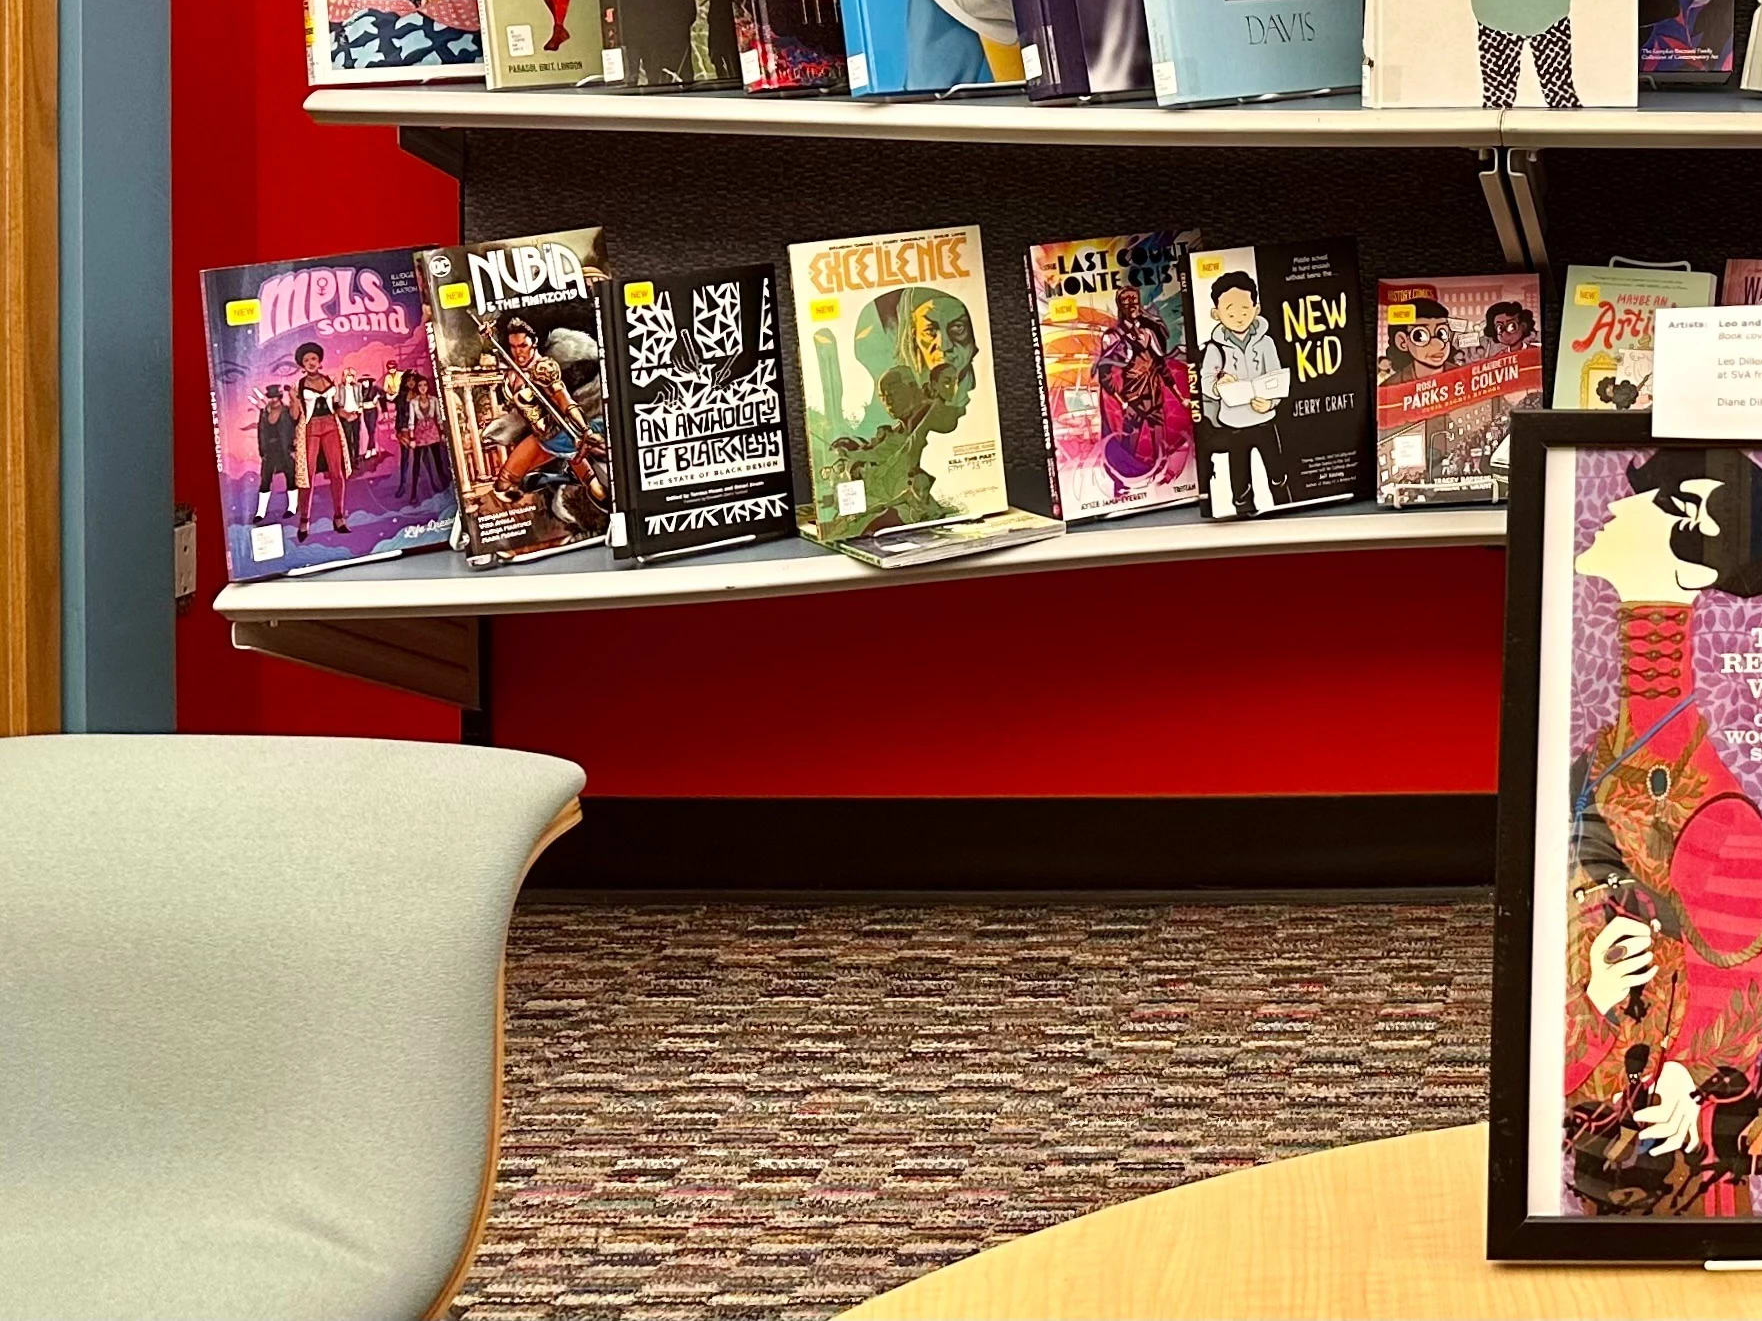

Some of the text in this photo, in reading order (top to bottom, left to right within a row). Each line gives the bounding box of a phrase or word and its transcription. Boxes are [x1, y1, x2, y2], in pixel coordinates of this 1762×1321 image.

[1245, 12, 1315, 45] DAVIS
[809, 237, 970, 294] EXCELLENCE
[1057, 250, 1109, 274] LAST
[431, 242, 588, 316] DC NUBIA
[1045, 271, 1122, 298] MONTE
[259, 268, 388, 344] MPLS
[500, 289, 578, 311] THE AMAZONS
[1617, 294, 1669, 307] MAYBE AN
[317, 306, 410, 335] sound
[1283, 292, 1346, 342] NEW
[1742, 319, 1761, 327] and
[1471, 354, 1519, 375] CLAUDETTE
[1403, 365, 1519, 411] PARKS & COLVIN
[1416, 379, 1437, 392] ROSA
[1293, 393, 1354, 417] JERRY CRAFT
[1717, 398, 1746, 407] Diane
[640, 396, 777, 443] AN ANTHOLOGY
[643, 431, 781, 471] OF BLACKNESS
[668, 460, 778, 484] STATE BLACK DESIGN
